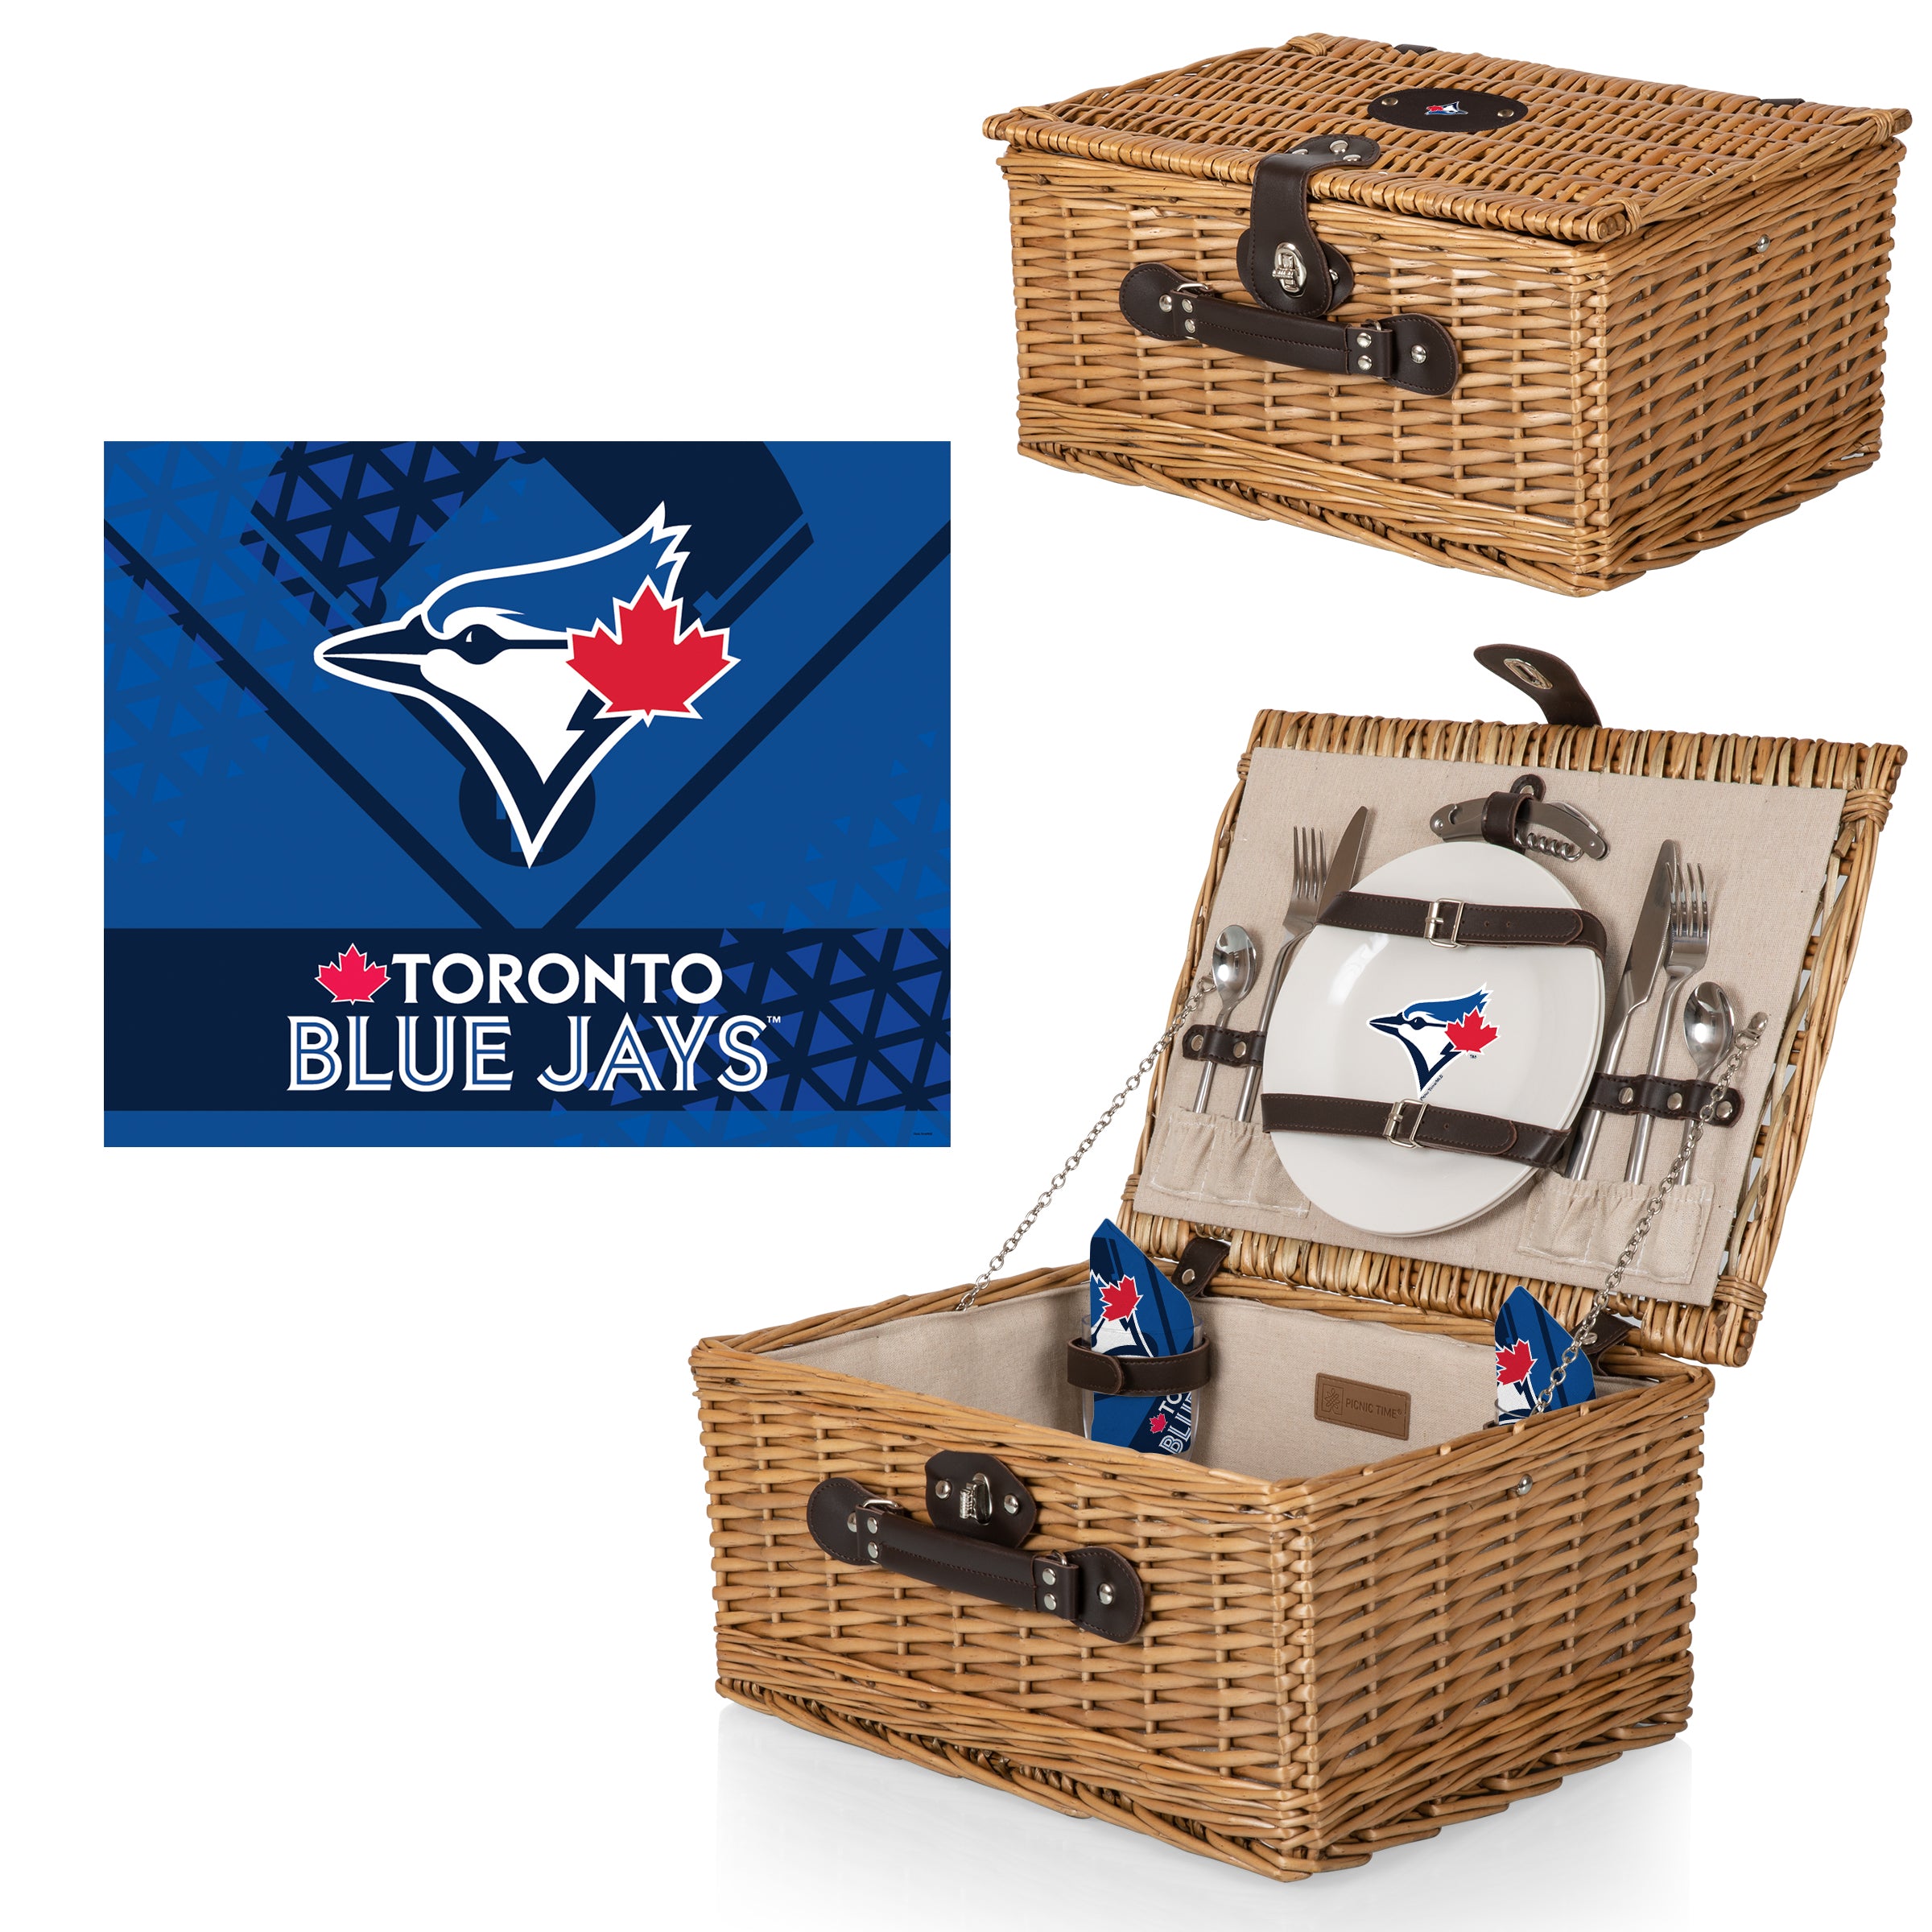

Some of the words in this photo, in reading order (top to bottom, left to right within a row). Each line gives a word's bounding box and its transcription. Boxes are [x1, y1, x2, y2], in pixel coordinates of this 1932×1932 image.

[391, 952, 723, 1005] TORONTO
[287, 1015, 514, 1092] BLUE
[1345, 1397, 1373, 1414] PICNIC
